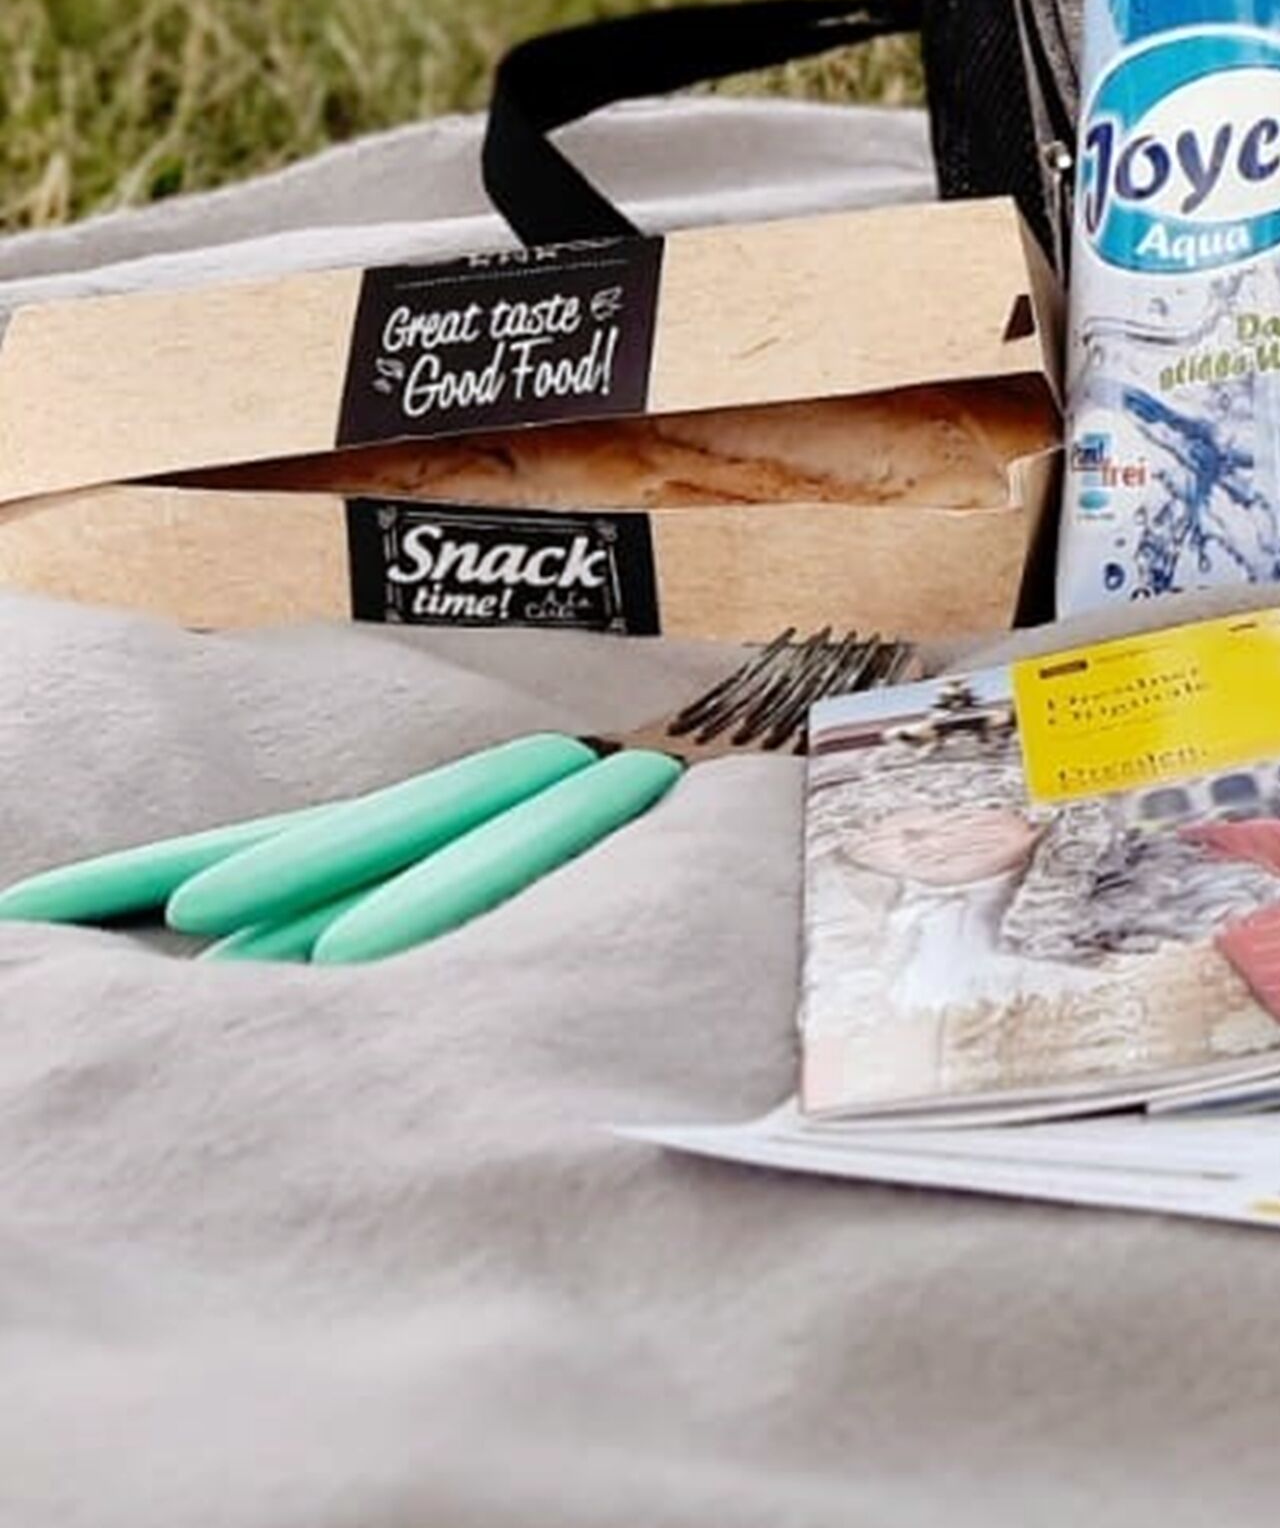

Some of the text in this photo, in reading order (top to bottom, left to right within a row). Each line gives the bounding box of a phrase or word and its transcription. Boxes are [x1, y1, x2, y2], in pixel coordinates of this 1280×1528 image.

[1135, 224, 1251, 268] Aqua
[382, 294, 581, 352] Great taste
[403, 326, 619, 417] Good Food!
[387, 524, 607, 588] Snack
[412, 583, 514, 619] time!
